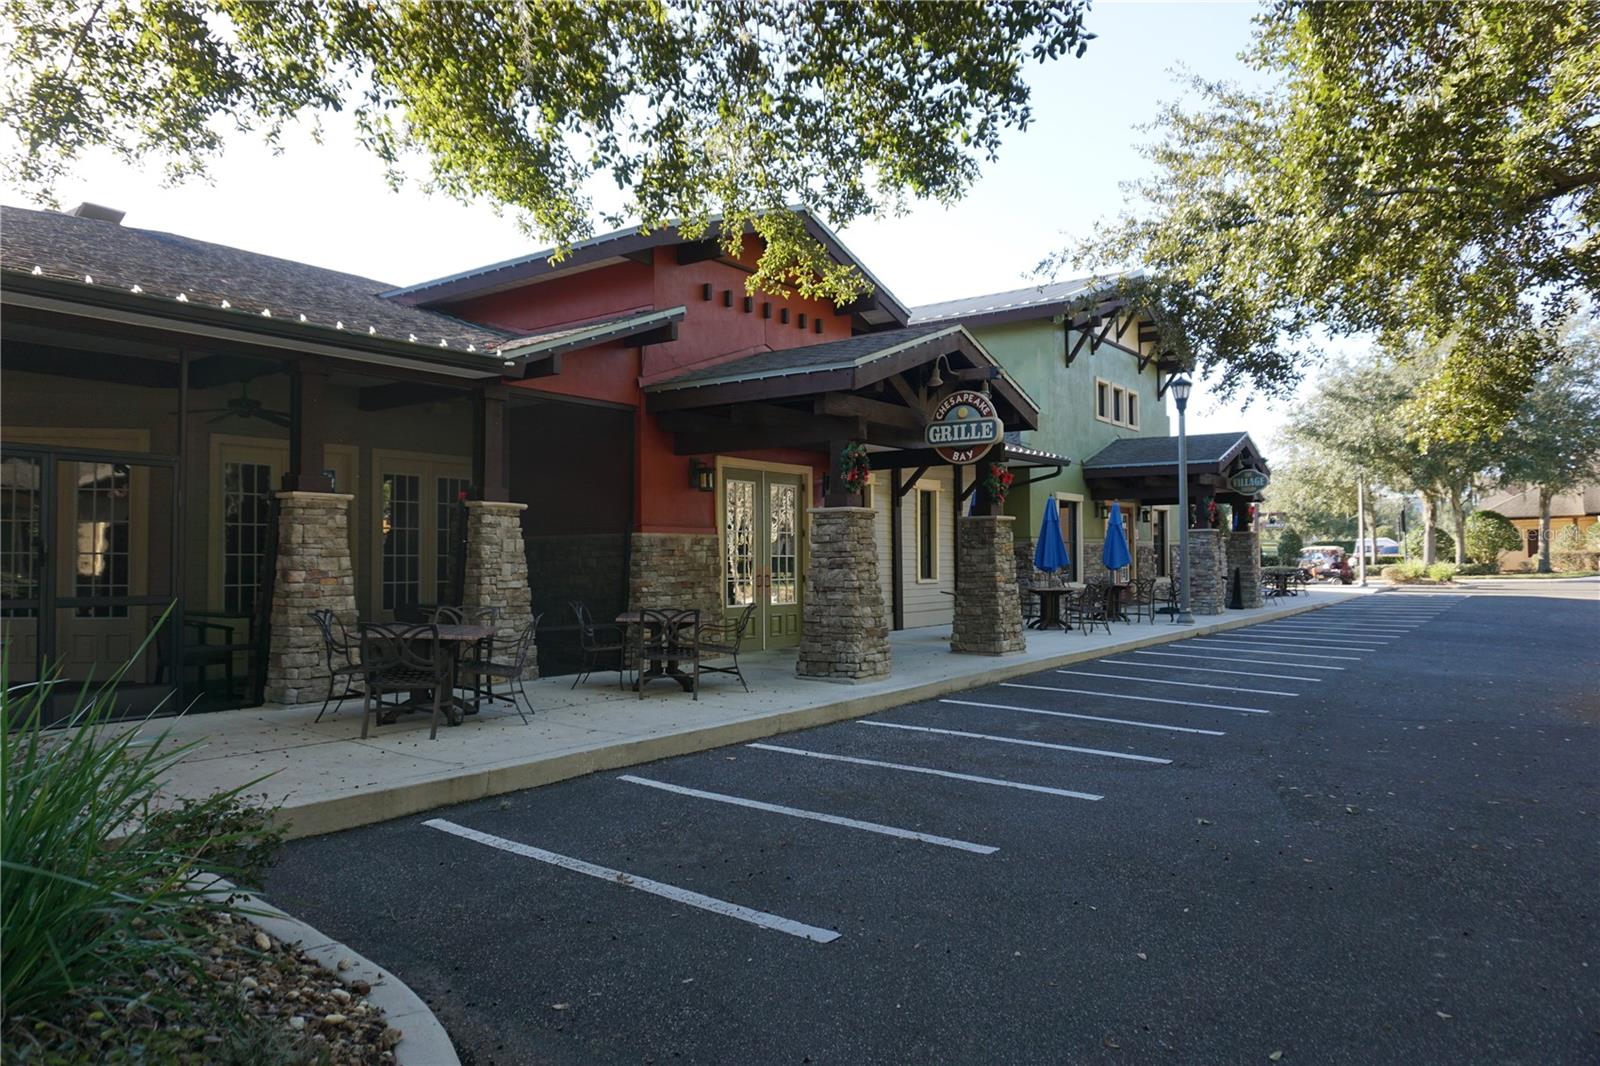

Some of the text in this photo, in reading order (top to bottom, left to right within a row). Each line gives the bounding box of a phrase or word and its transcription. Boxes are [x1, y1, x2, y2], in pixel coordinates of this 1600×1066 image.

[936, 394, 990, 419] CHESAPEAKE
[929, 422, 993, 442] GRILLE
[953, 450, 973, 461] BAY
